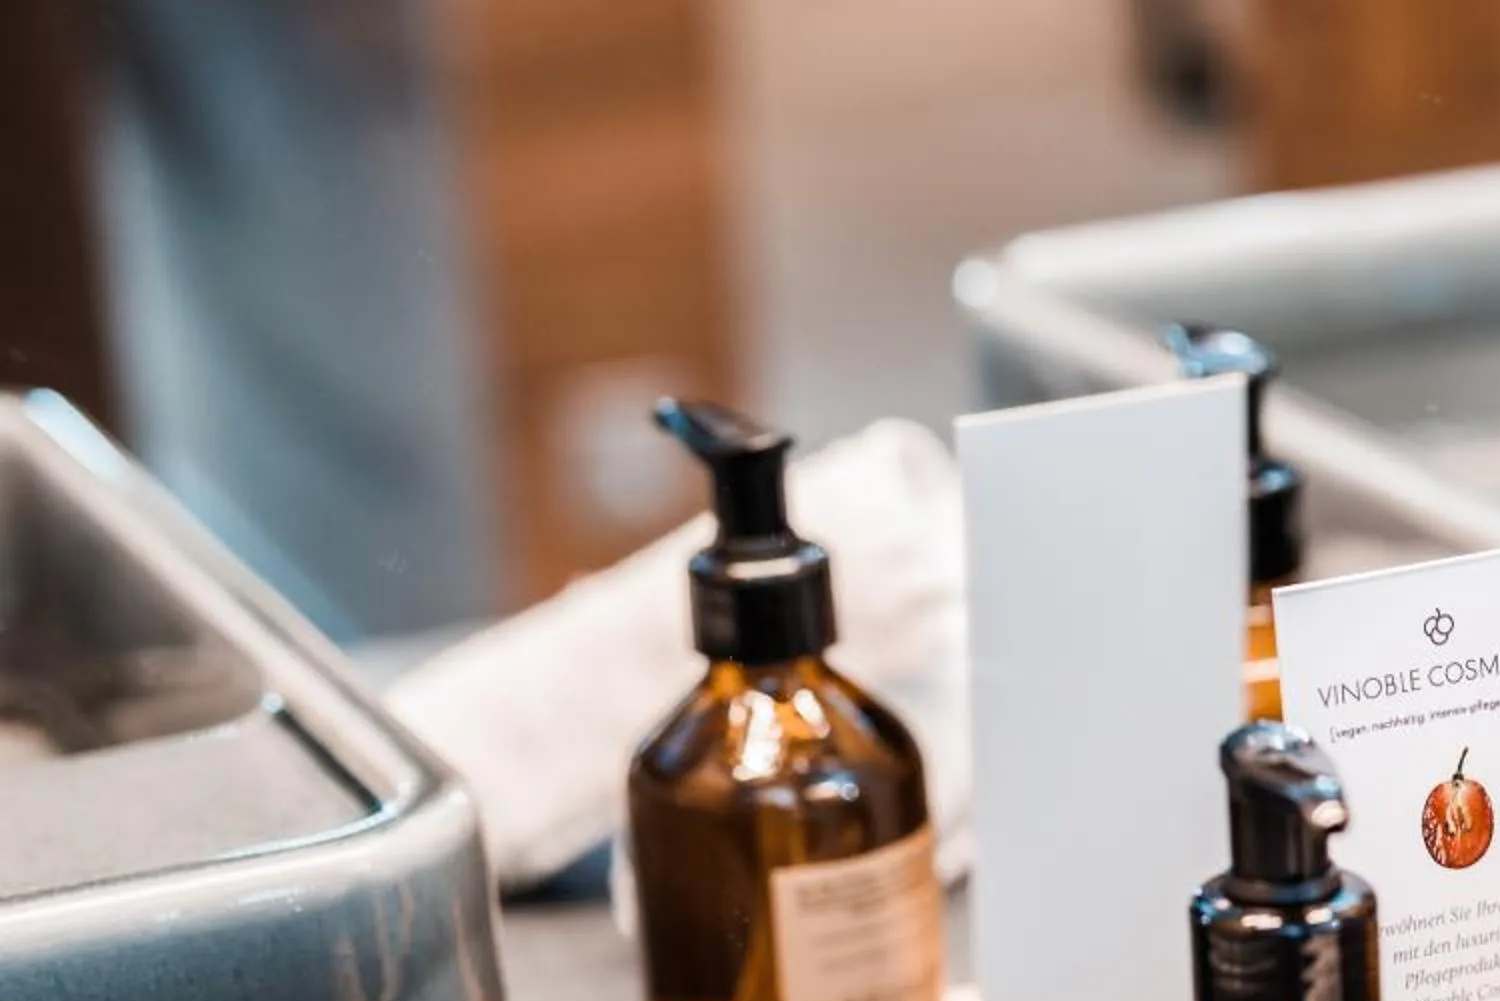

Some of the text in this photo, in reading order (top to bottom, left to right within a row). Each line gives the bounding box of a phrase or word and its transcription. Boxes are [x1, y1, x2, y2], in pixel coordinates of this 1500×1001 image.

[1317, 669, 1421, 708] VINOBLE
[1379, 912, 1446, 938] rwöhnen
[1449, 904, 1471, 924] Sie
[1392, 946, 1420, 965] mit
[1423, 937, 1451, 958] den
